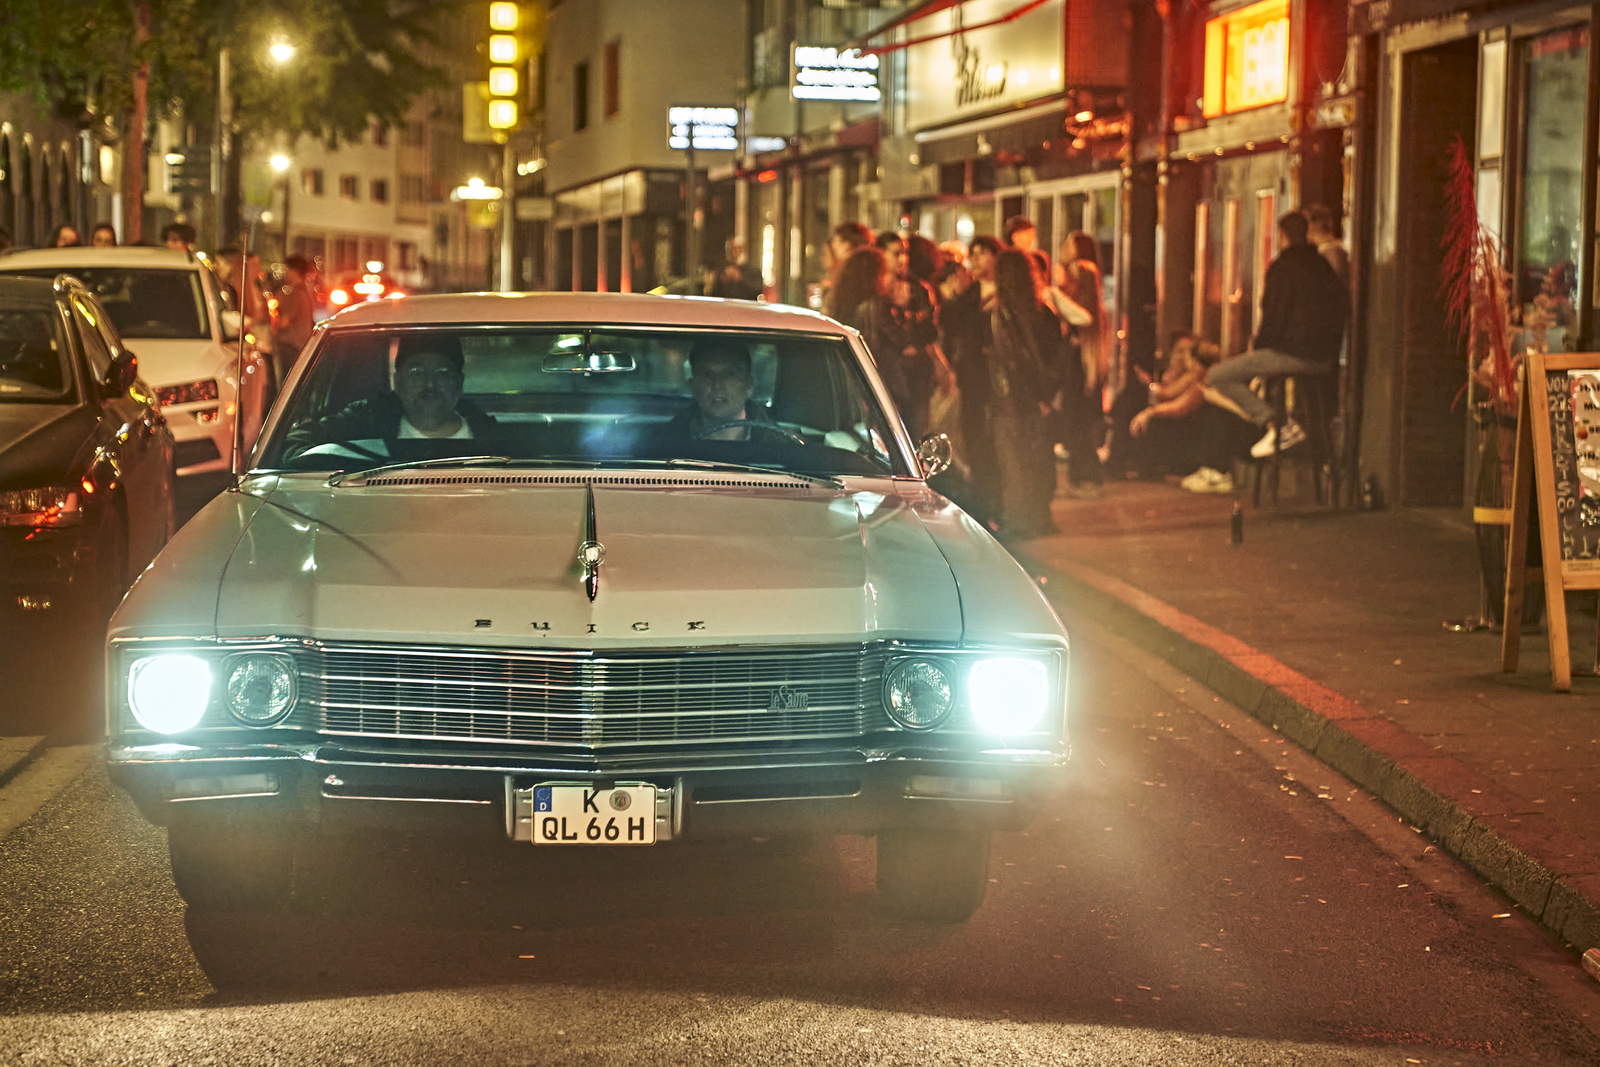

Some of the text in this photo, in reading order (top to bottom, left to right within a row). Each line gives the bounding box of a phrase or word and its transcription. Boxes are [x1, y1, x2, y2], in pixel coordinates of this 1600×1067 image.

[474, 618, 706, 633] BUICK
[540, 802, 547, 811] D
[583, 789, 600, 814] K
[542, 816, 578, 841] QL
